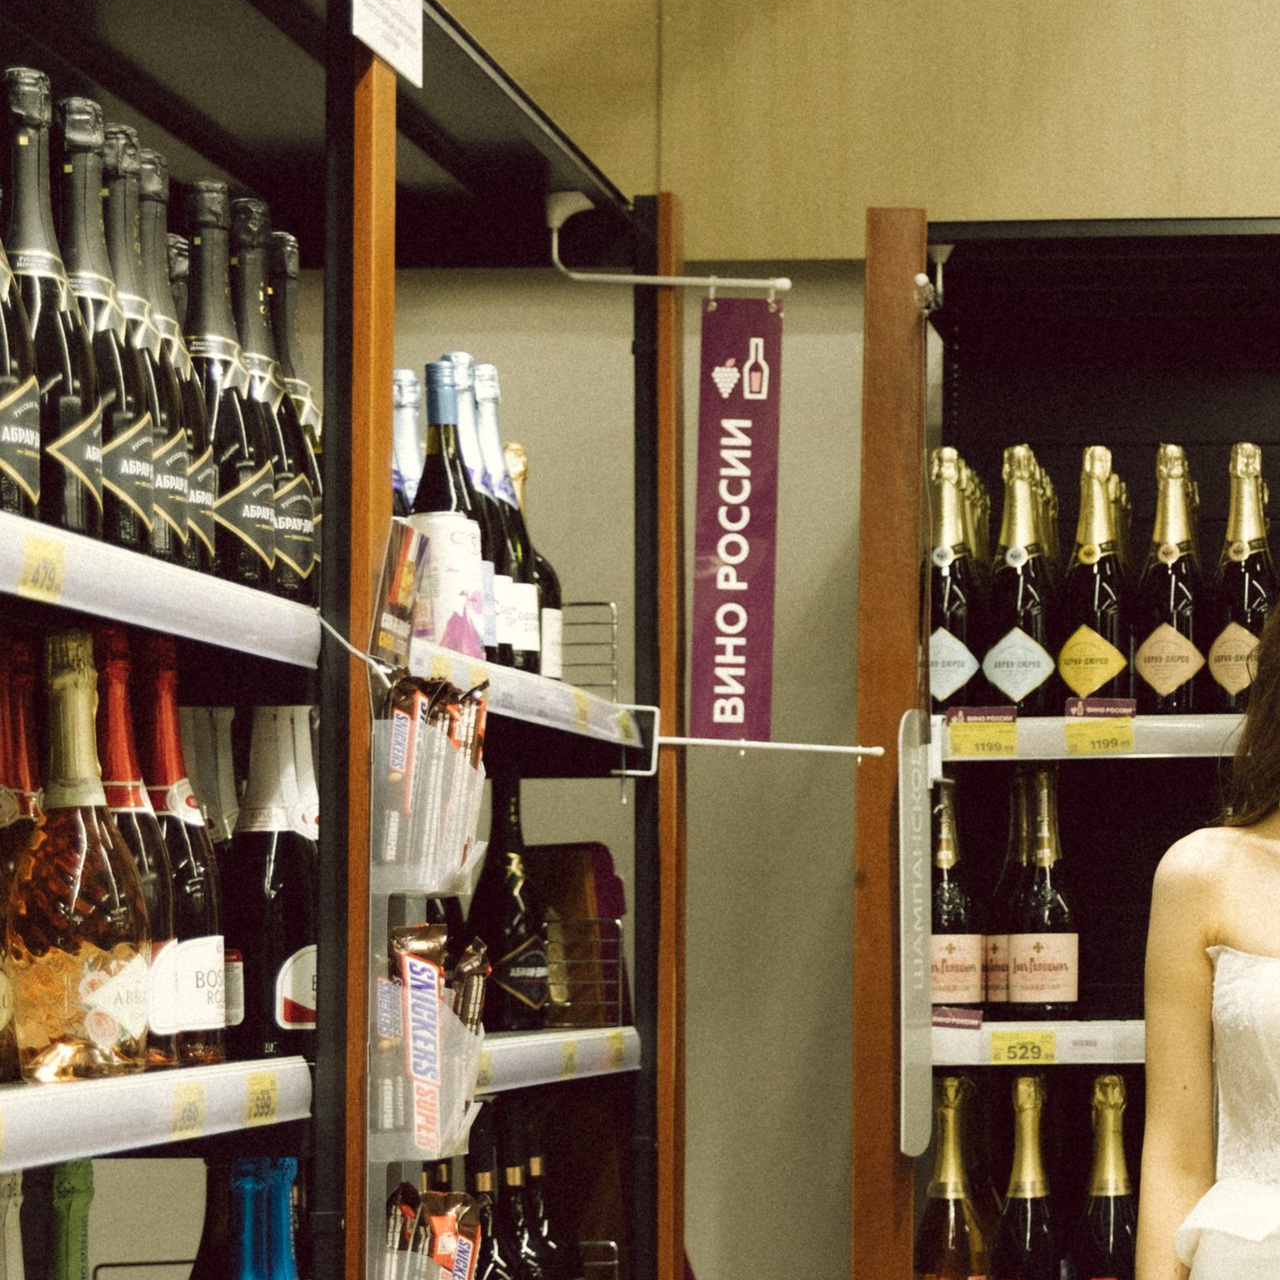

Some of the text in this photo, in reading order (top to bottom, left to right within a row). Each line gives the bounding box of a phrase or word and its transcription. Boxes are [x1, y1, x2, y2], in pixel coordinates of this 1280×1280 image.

[712, 418, 752, 724] ВИНО РОССИИ
[409, 960, 438, 1151] SNICKERS SUPER
